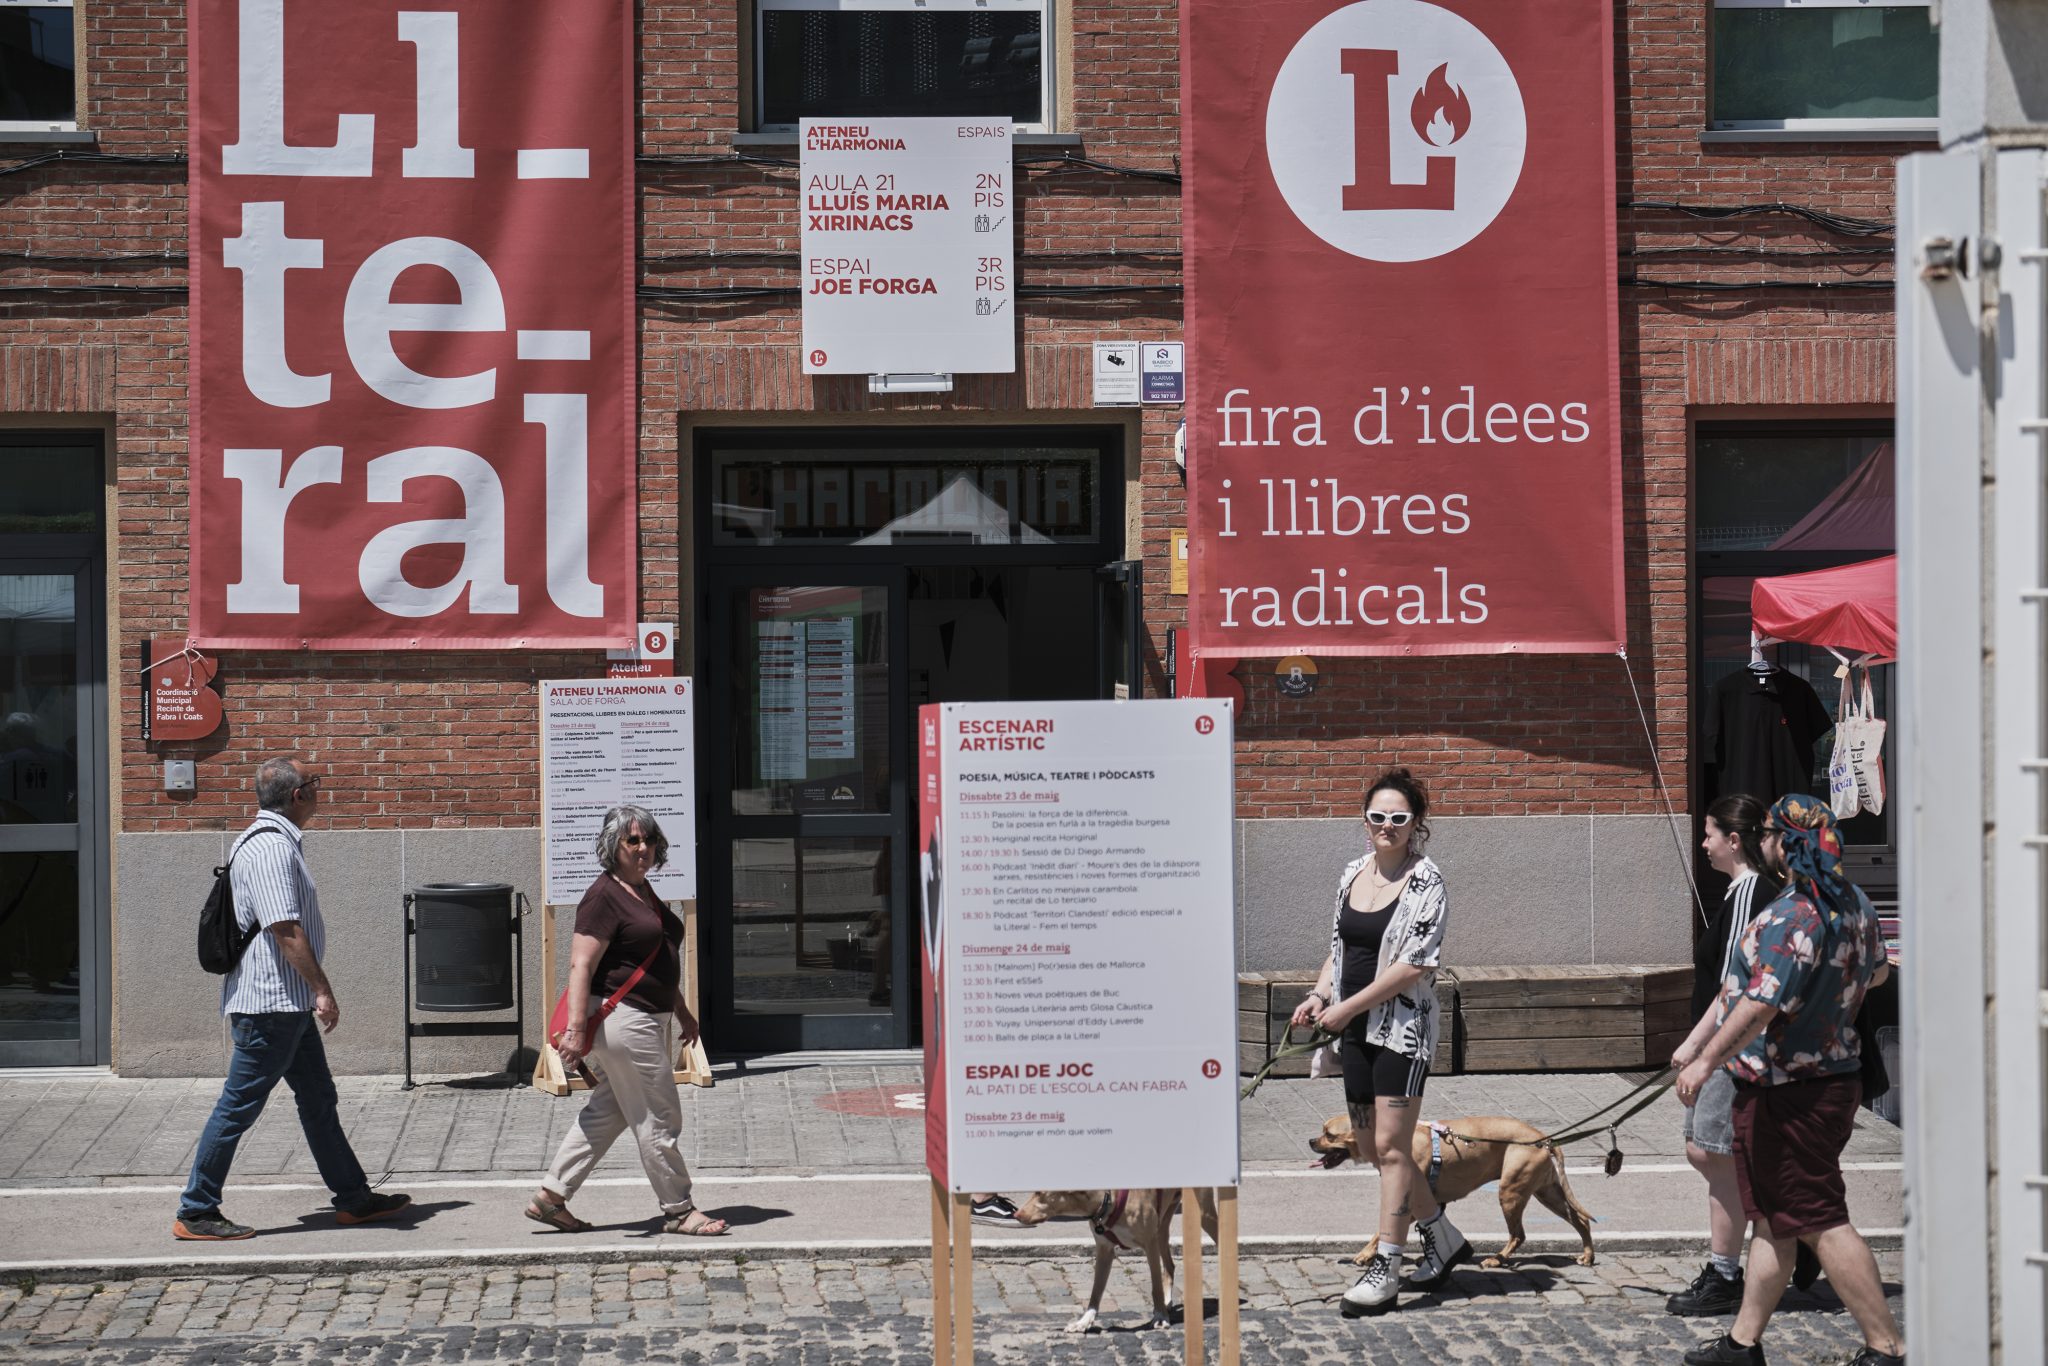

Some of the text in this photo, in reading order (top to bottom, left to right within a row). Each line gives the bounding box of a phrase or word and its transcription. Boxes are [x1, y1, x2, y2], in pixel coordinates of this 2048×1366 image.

[222, 0, 590, 179] Li-
[807, 126, 869, 138] ATENEU
[958, 126, 1005, 138] ESPAIS
[807, 139, 906, 151] L'HARMONIA
[808, 174, 895, 191] AULA 21
[976, 174, 1001, 189] 2N
[808, 191, 950, 211] LLUÍS MARIA
[975, 192, 1004, 207] PIS
[808, 214, 913, 231] XIRINACS
[810, 258, 870, 275] ESPAI
[977, 258, 1002, 273] 3R
[809, 278, 937, 295] JOE FORGA
[976, 276, 1005, 291] PIS
[222, 201, 590, 409] te-
[1217, 386, 1590, 446] fira d'idees
[222, 393, 604, 617] ral
[1218, 478, 1470, 536] i llibres
[1220, 567, 1489, 627] radicals
[652, 636, 660, 648] 8
[611, 664, 652, 673] Ateneu
[550, 686, 667, 696] ATENEU L'HARMONIA
[157, 697, 192, 705] Municipal
[576, 698, 593, 706] JOE
[595, 697, 626, 705] FORGA
[959, 719, 1054, 734] ESCENARI
[959, 734, 1045, 752] ARTÍSTIC
[960, 774, 1001, 783] POESIA,
[1005, 771, 1047, 782] MÚSICA,
[1051, 772, 1090, 780] TEATRE
[1099, 770, 1155, 780] PÒDCASTS
[960, 790, 1060, 803] Dissabte 23 de maig
[1039, 810, 1073, 819] força de
[1016, 821, 1044, 829] poesia
[1136, 819, 1170, 827] burgesa
[1022, 847, 1146, 856] Sessió de Diego Armando
[1108, 871, 1137, 879] formes
[1055, 886, 1090, 895] menjava
[1112, 909, 1137, 917] edició
[1140, 908, 1175, 917] especial
[1004, 923, 1030, 931] Literal
[1071, 922, 1097, 930] temps
[962, 942, 1071, 955] Diumenge 24 de maig
[1097, 961, 1107, 969] de
[1110, 961, 1146, 969] Mallorca
[995, 1006, 1030, 1014] Glosada
[1069, 1004, 1088, 1012] amb
[1025, 1019, 1075, 1028] Unipersonal
[1110, 1017, 1144, 1025] Laverde
[1031, 1033, 1054, 1042] plaça
[1074, 1032, 1100, 1040] Literal
[966, 1063, 1094, 1079] ESPAI DE JOC
[966, 1080, 1188, 1096] AL PATI DE L'ESCOLA CAN FABRA
[965, 1110, 1065, 1122] Dissabte 23 de maig
[997, 1130, 1034, 1138] Imaginar
[1068, 1129, 1085, 1137] que
